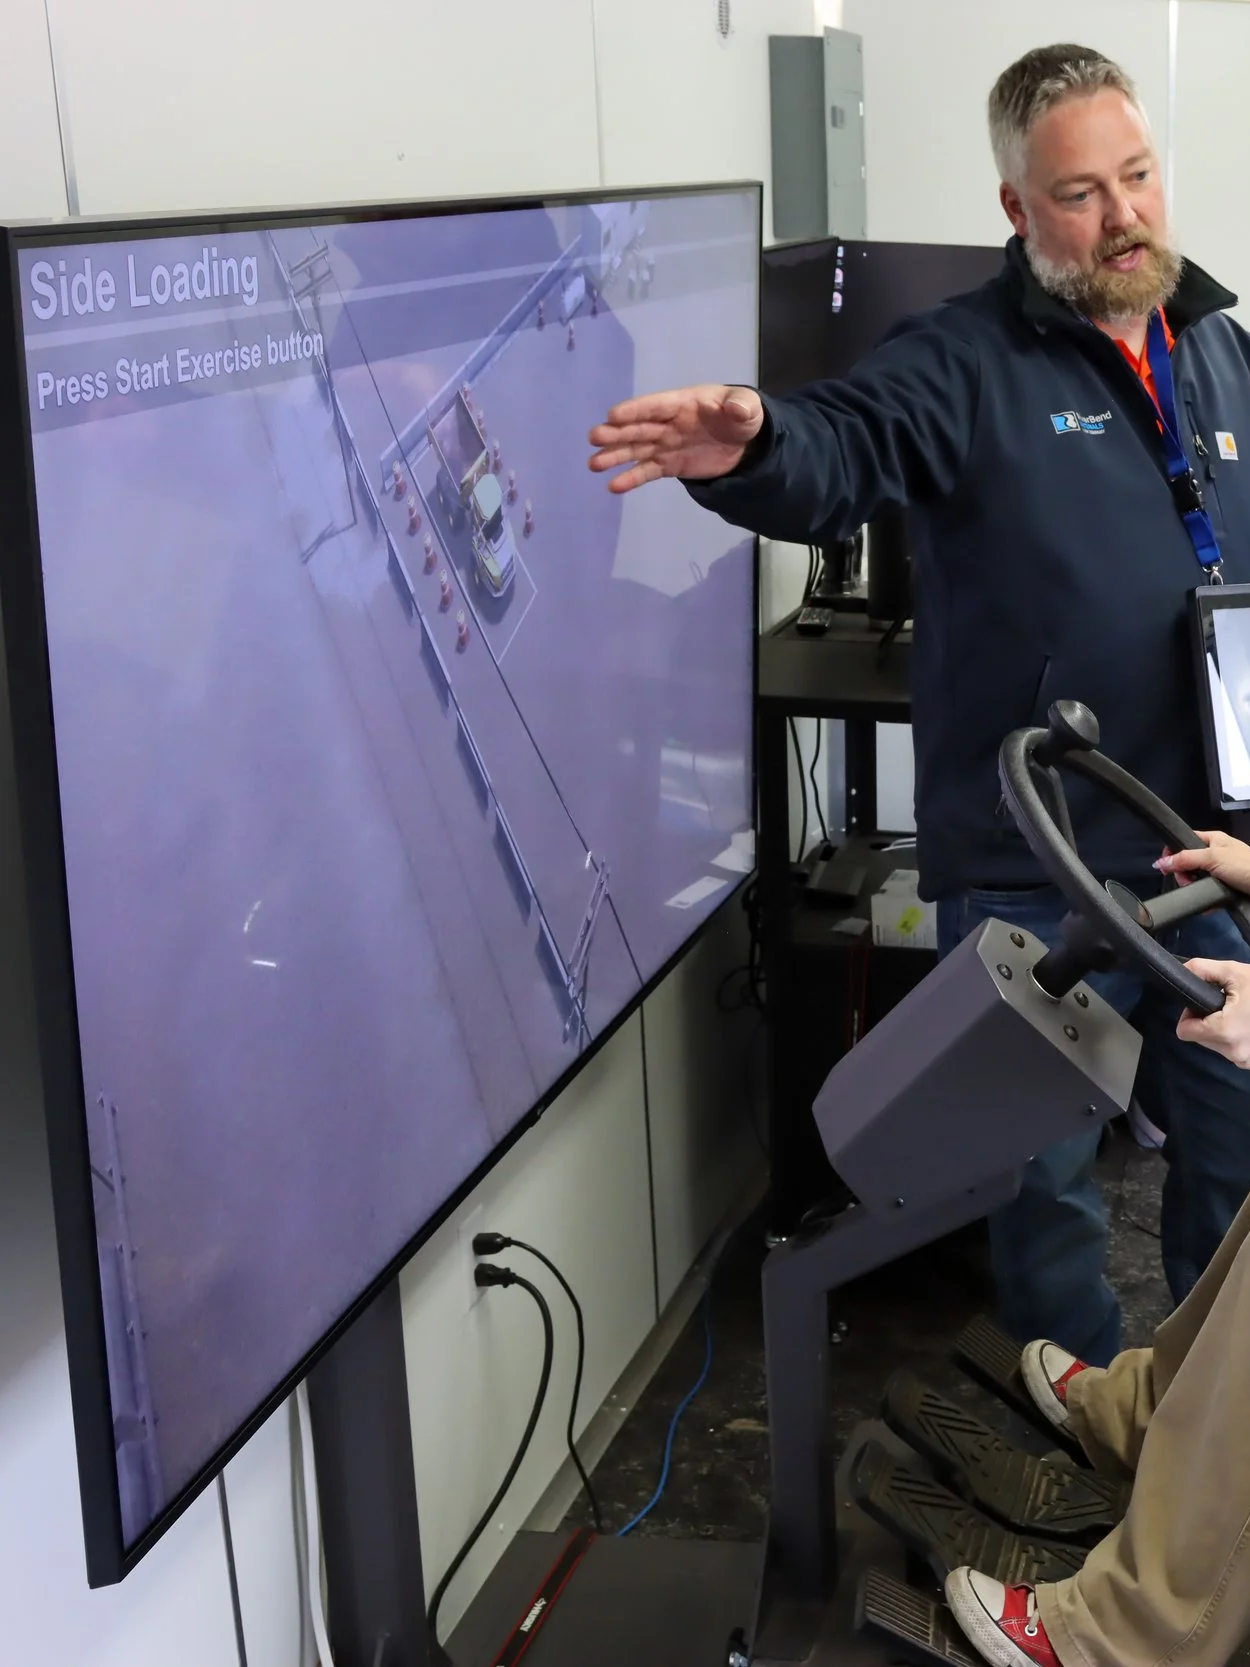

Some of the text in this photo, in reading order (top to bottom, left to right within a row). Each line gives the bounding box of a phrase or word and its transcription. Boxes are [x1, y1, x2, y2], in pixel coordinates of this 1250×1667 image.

[30, 247, 259, 320] Side Loading
[37, 330, 324, 410] Press Start Exercise button
